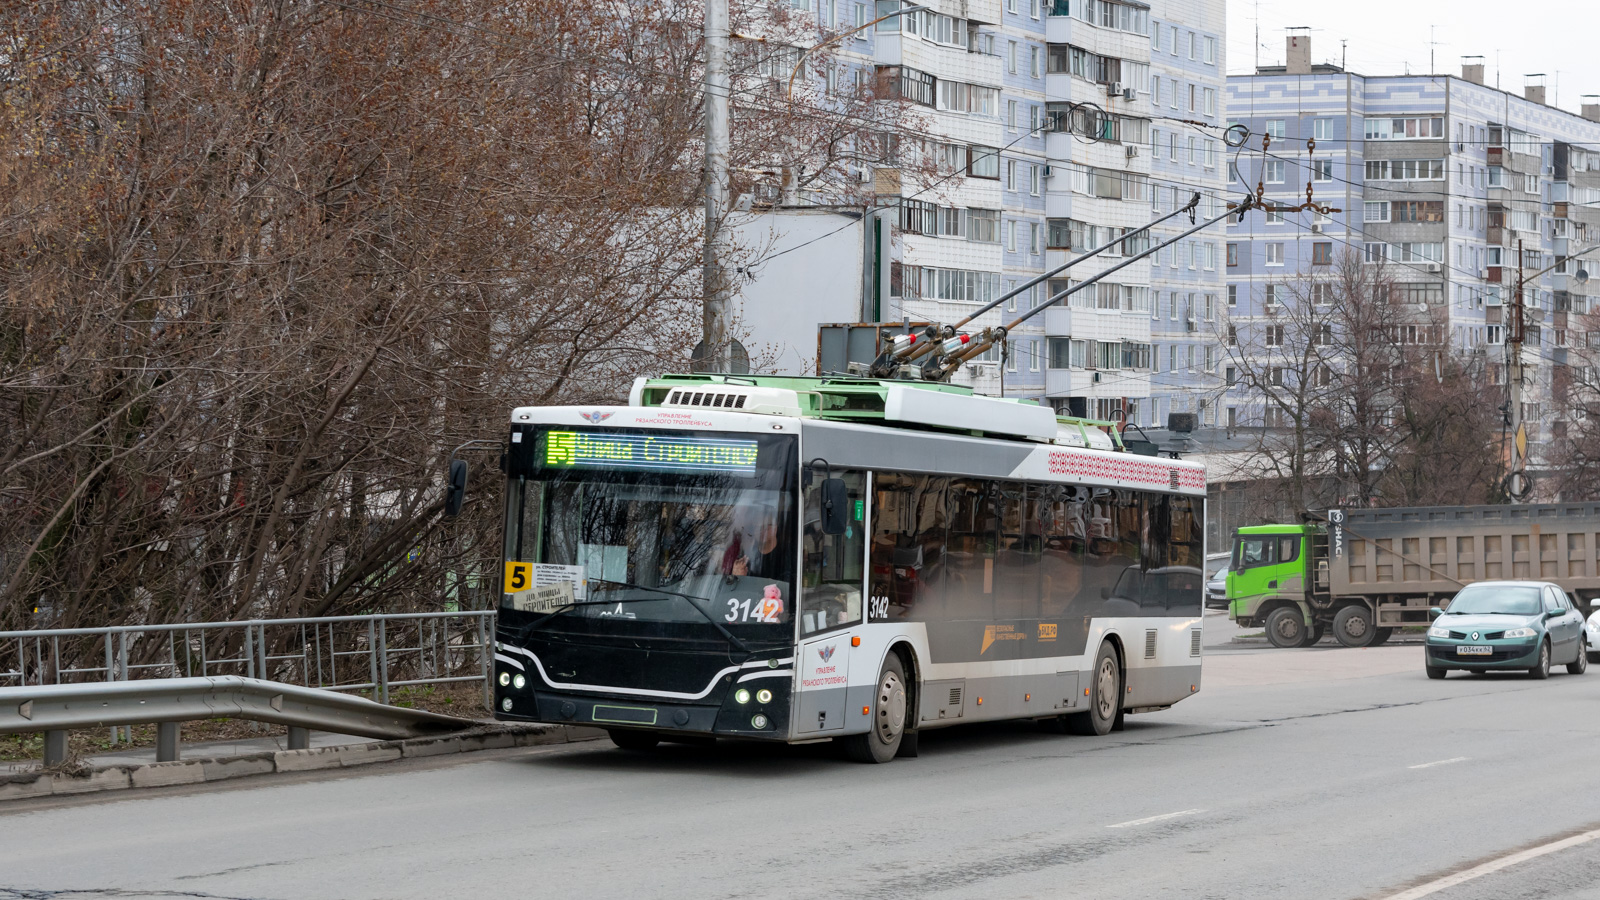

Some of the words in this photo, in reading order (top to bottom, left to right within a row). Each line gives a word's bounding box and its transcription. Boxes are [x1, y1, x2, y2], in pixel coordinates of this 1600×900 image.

[673, 419, 712, 427] ТРОЛЛЕЙБУСА
[511, 566, 525, 588] 5
[725, 598, 779, 622] 3142
[870, 596, 889, 618] 3142
